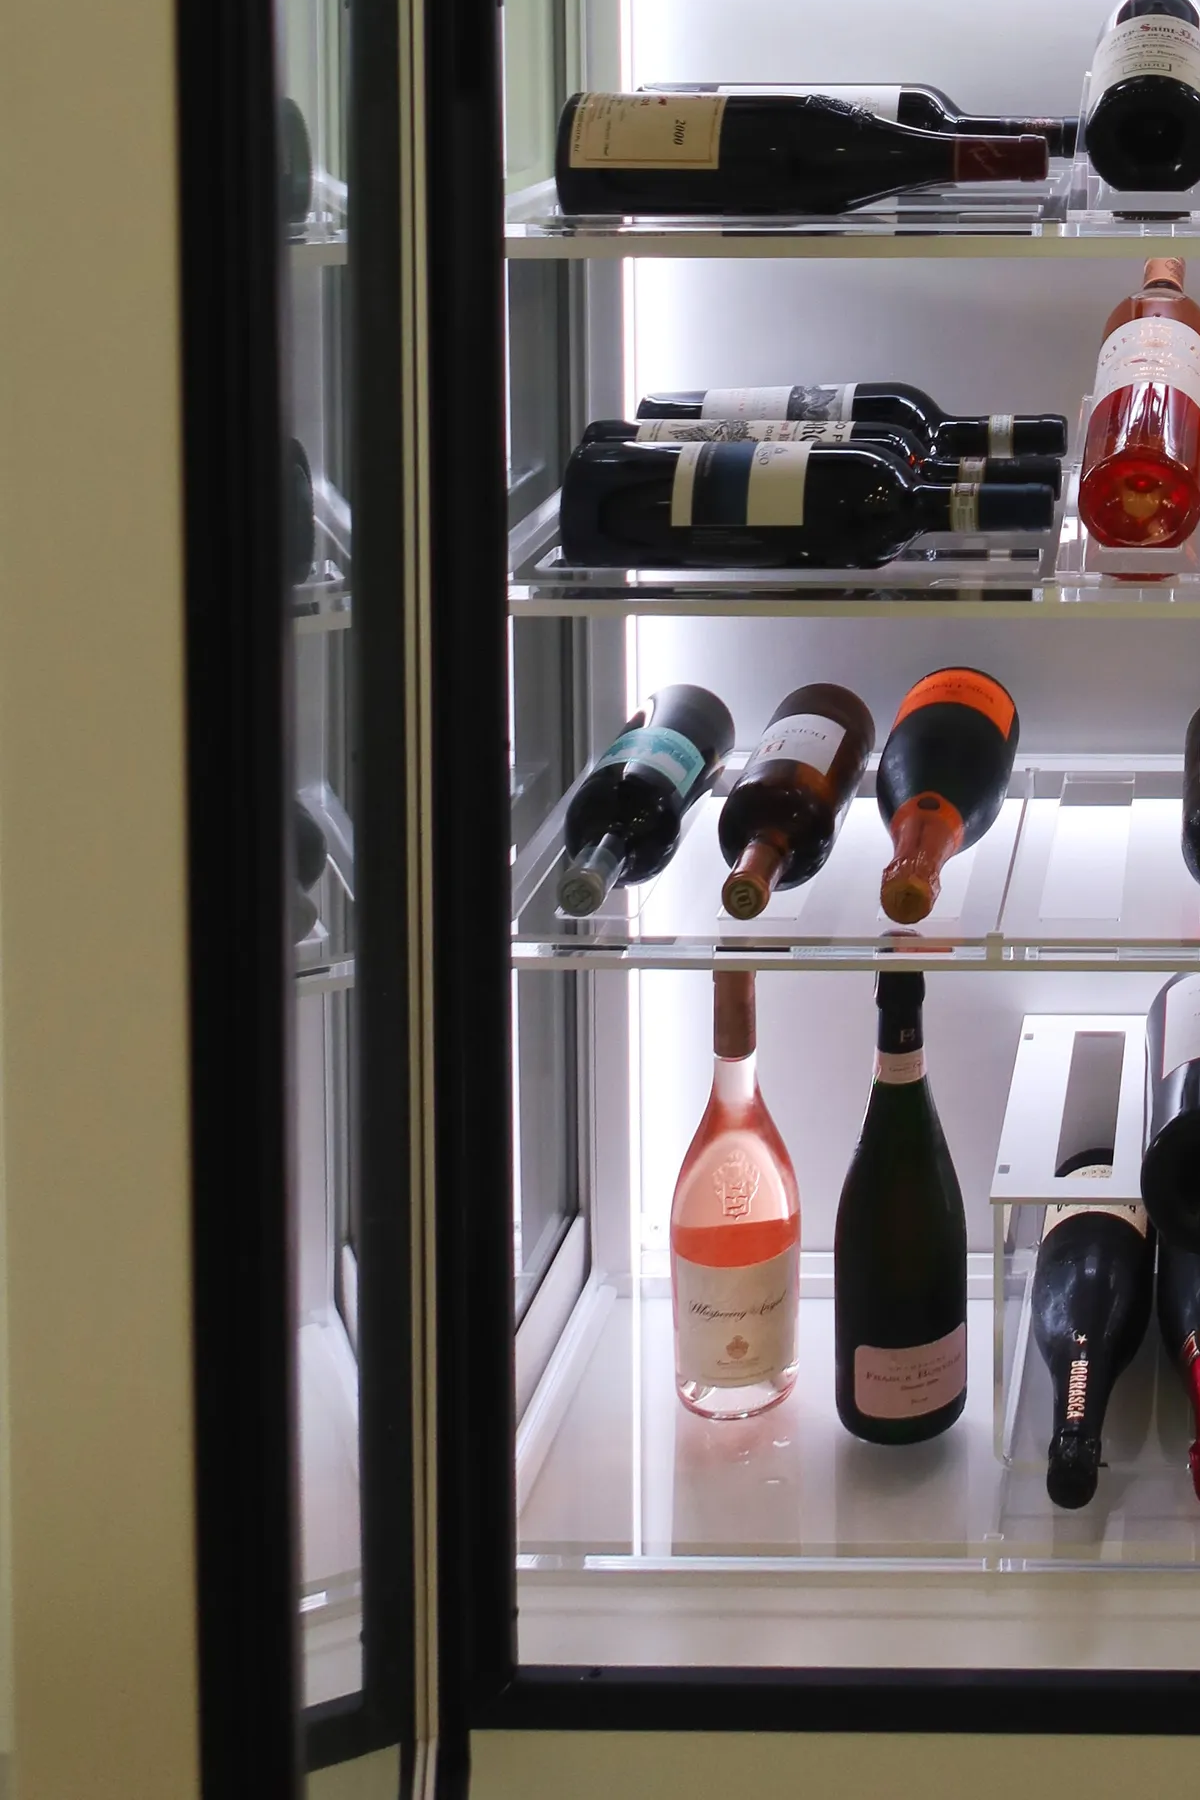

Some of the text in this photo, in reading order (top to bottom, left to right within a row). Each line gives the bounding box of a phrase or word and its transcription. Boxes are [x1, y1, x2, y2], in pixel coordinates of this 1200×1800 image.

[673, 119, 686, 146] 2000
[688, 1299, 749, 1321] Whispering
[1066, 1360, 1090, 1421] BORRASCA
